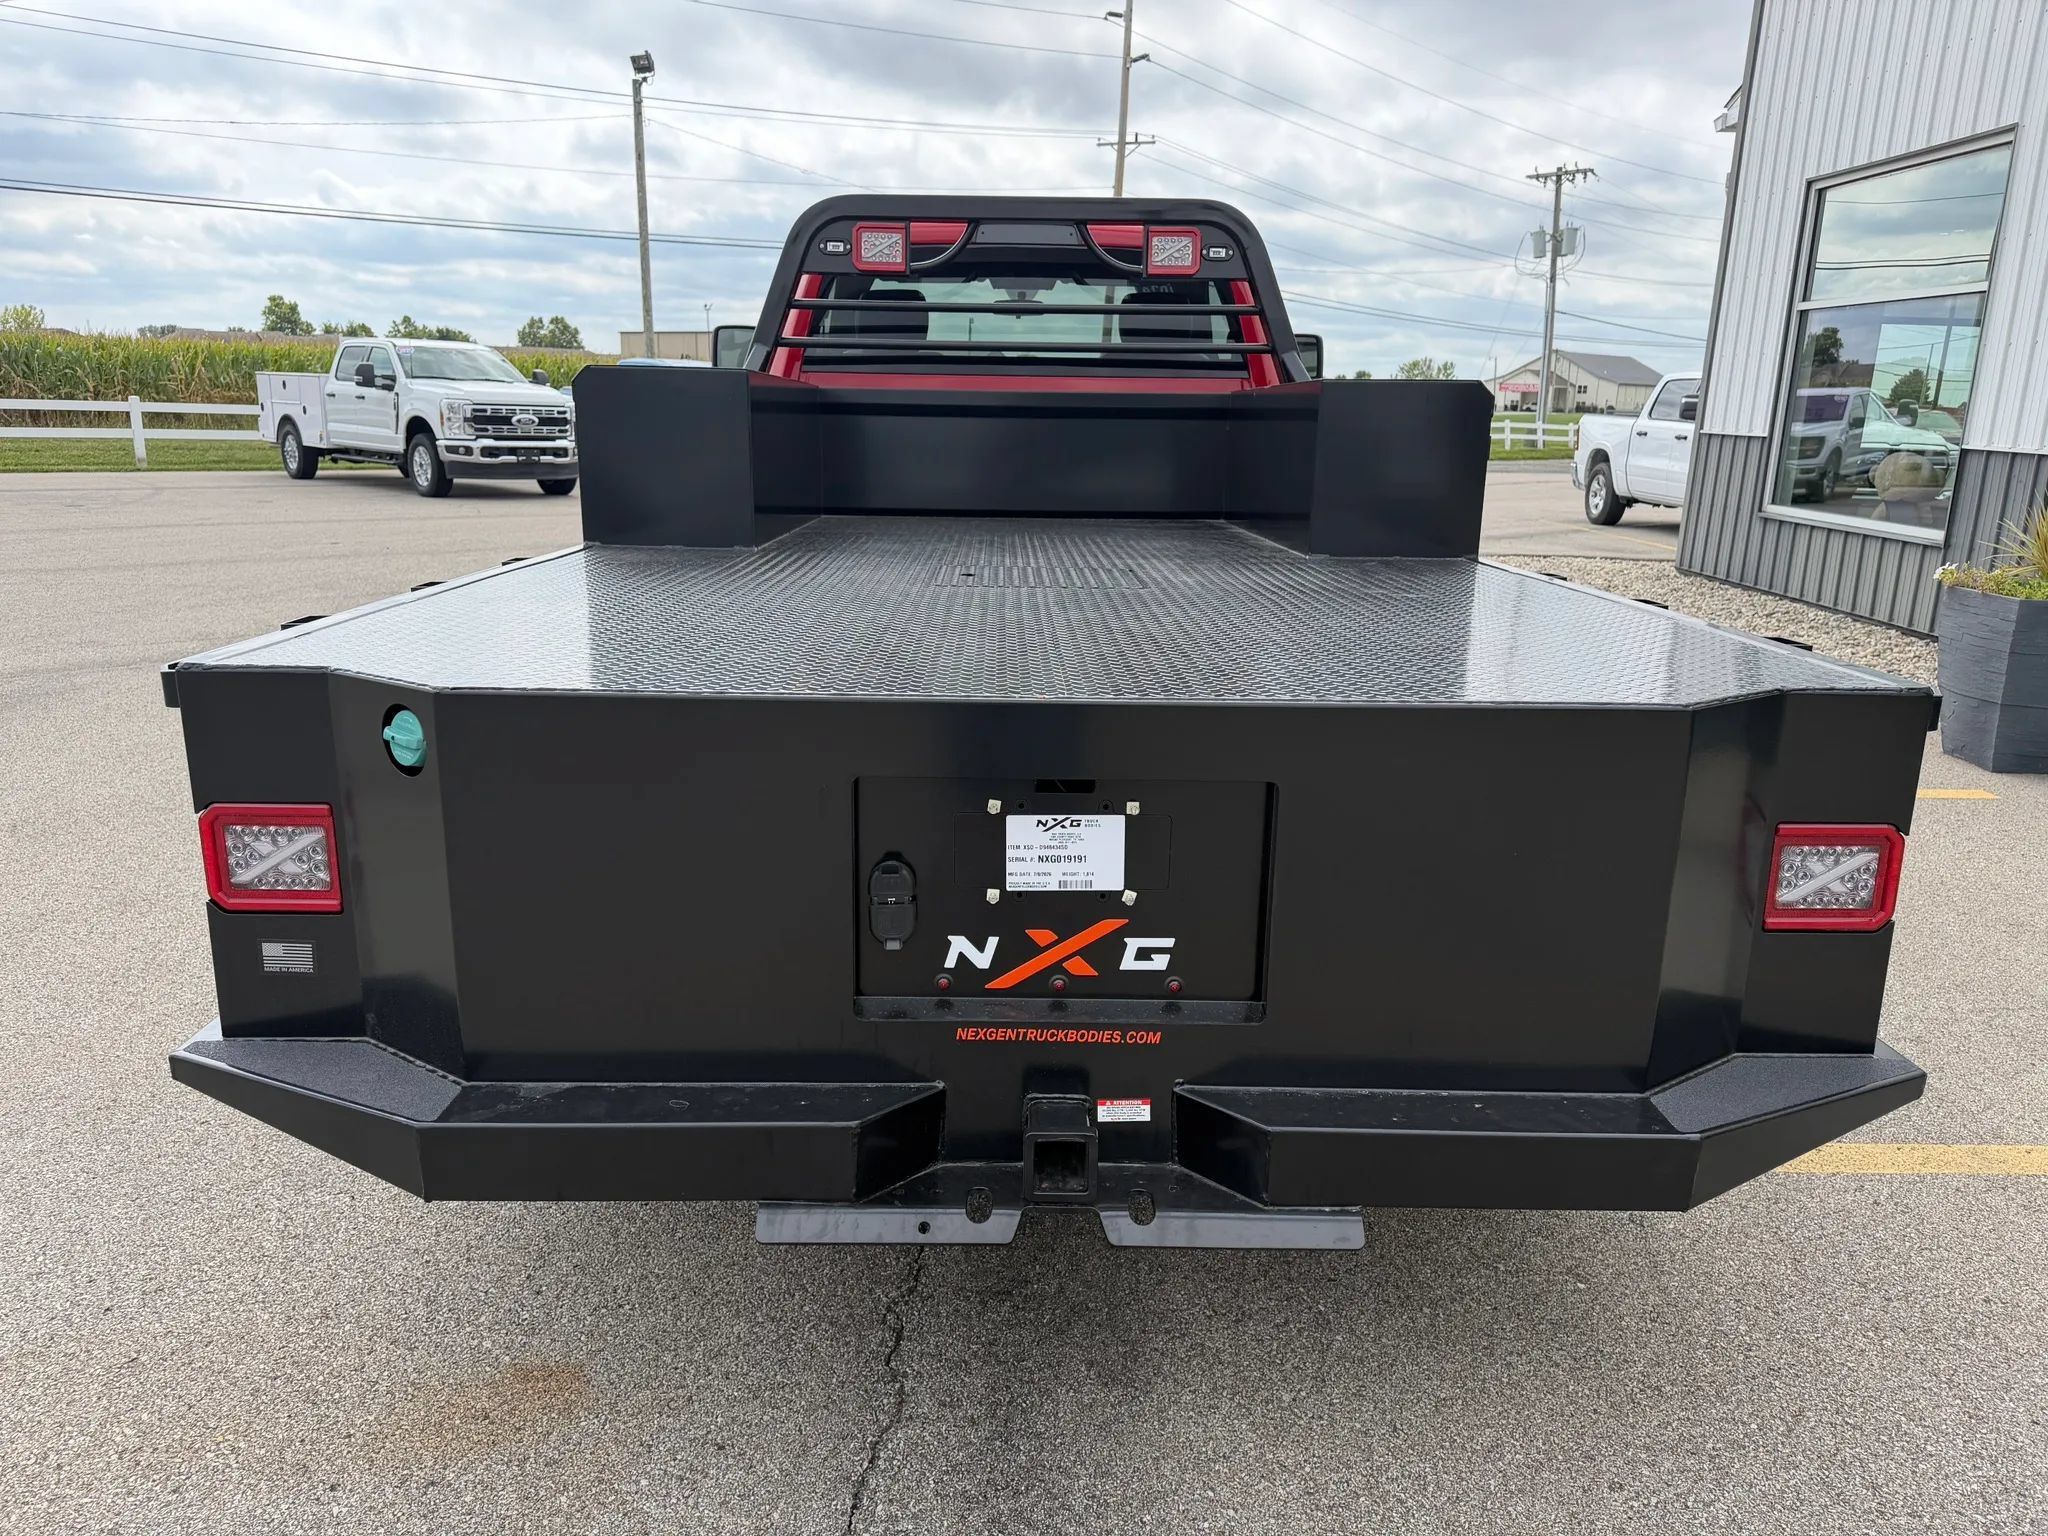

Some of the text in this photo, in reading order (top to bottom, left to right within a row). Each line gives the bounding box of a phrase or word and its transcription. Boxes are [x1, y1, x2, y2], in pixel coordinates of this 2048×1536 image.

[1036, 817, 1082, 832] NXG
[1037, 855, 1087, 863] NXG019191
[944, 919, 1175, 989] NXG
[956, 1027, 1162, 1044] NEXGENTRUCKBODIES.COM
